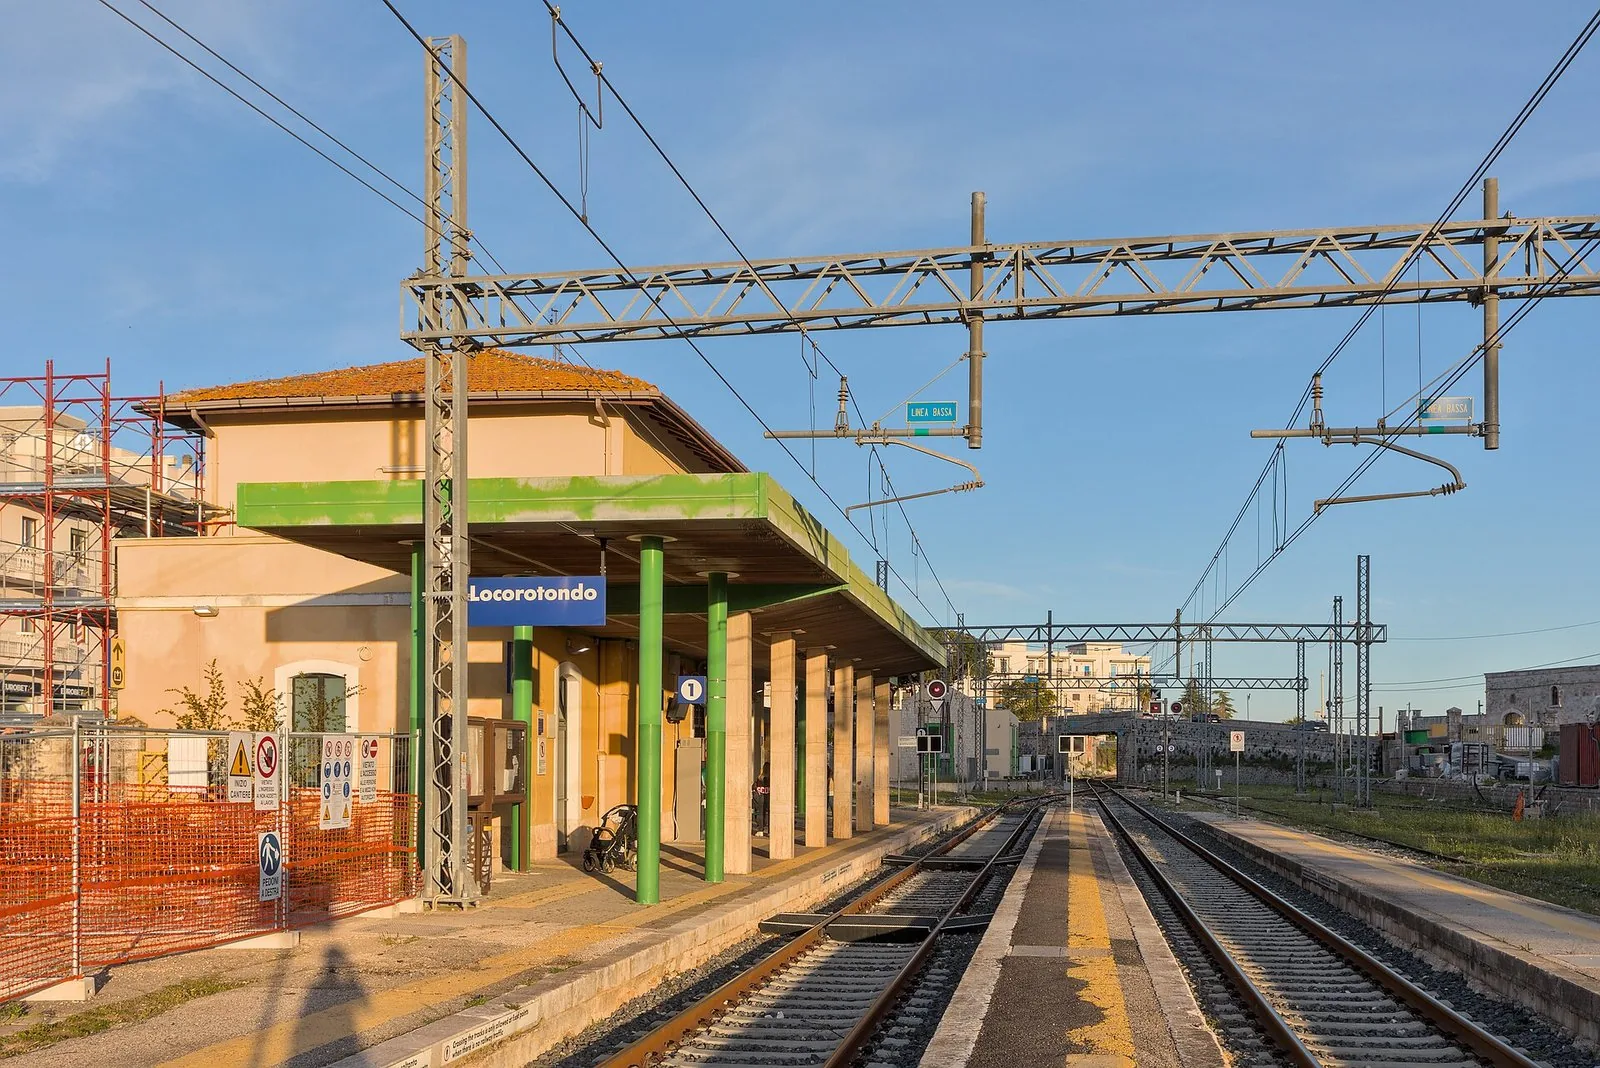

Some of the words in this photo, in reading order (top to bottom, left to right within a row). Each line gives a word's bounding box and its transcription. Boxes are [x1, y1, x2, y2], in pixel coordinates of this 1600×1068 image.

[911, 407, 929, 417] LINEA
[932, 407, 953, 417] BASSA
[1446, 403, 1468, 413] BASSA
[469, 583, 598, 602] Locorotondo
[3, 683, 29, 692] UROBET
[230, 790, 251, 799] CANTIERE
[262, 876, 279, 887] PEDONI
[265, 886, 279, 897] DESTRA
